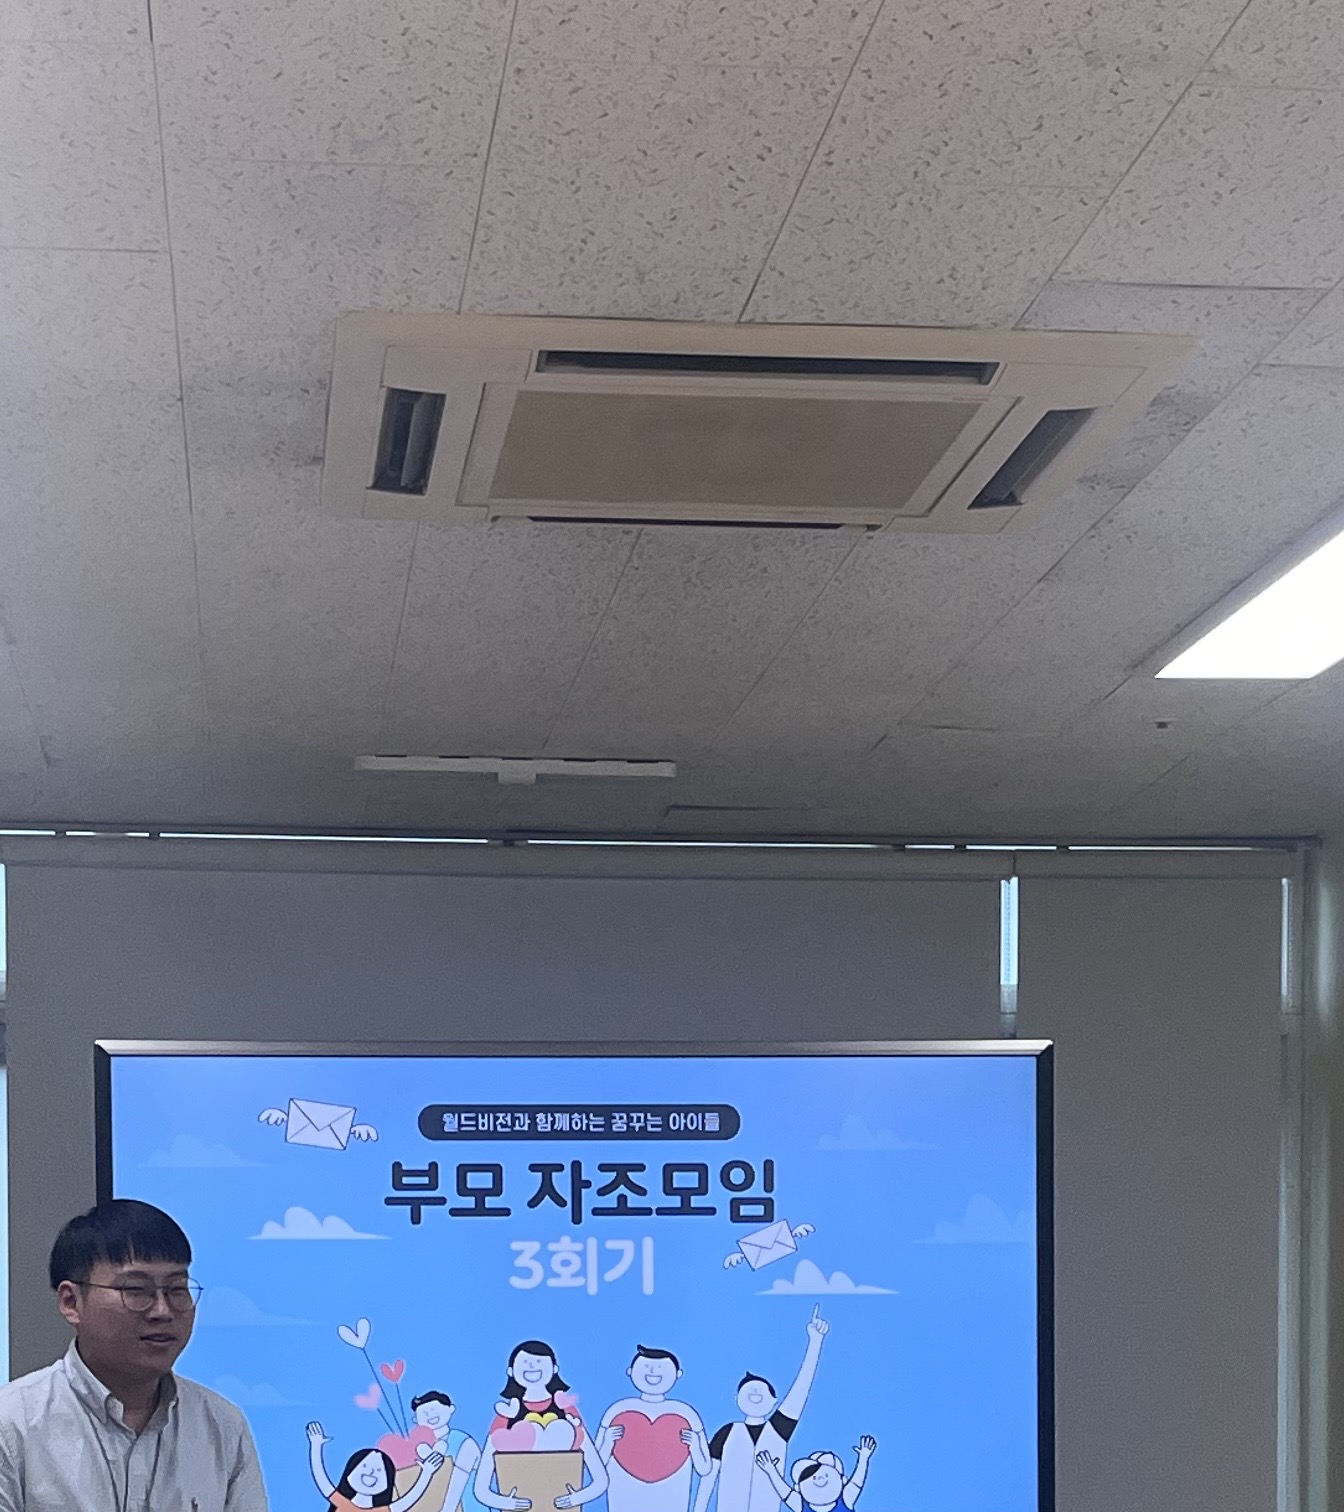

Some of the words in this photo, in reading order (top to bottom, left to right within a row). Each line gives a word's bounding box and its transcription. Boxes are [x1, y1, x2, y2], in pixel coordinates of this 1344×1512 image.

[442, 1113, 531, 1133] 월드비전과
[535, 1112, 606, 1132] 함께하는
[610, 1112, 663, 1132] 꿈꾸는
[668, 1112, 721, 1132] 아이들
[384, 1160, 512, 1225] 부모
[526, 1159, 776, 1225] 자조모임
[508, 1235, 655, 1296] 3회기
